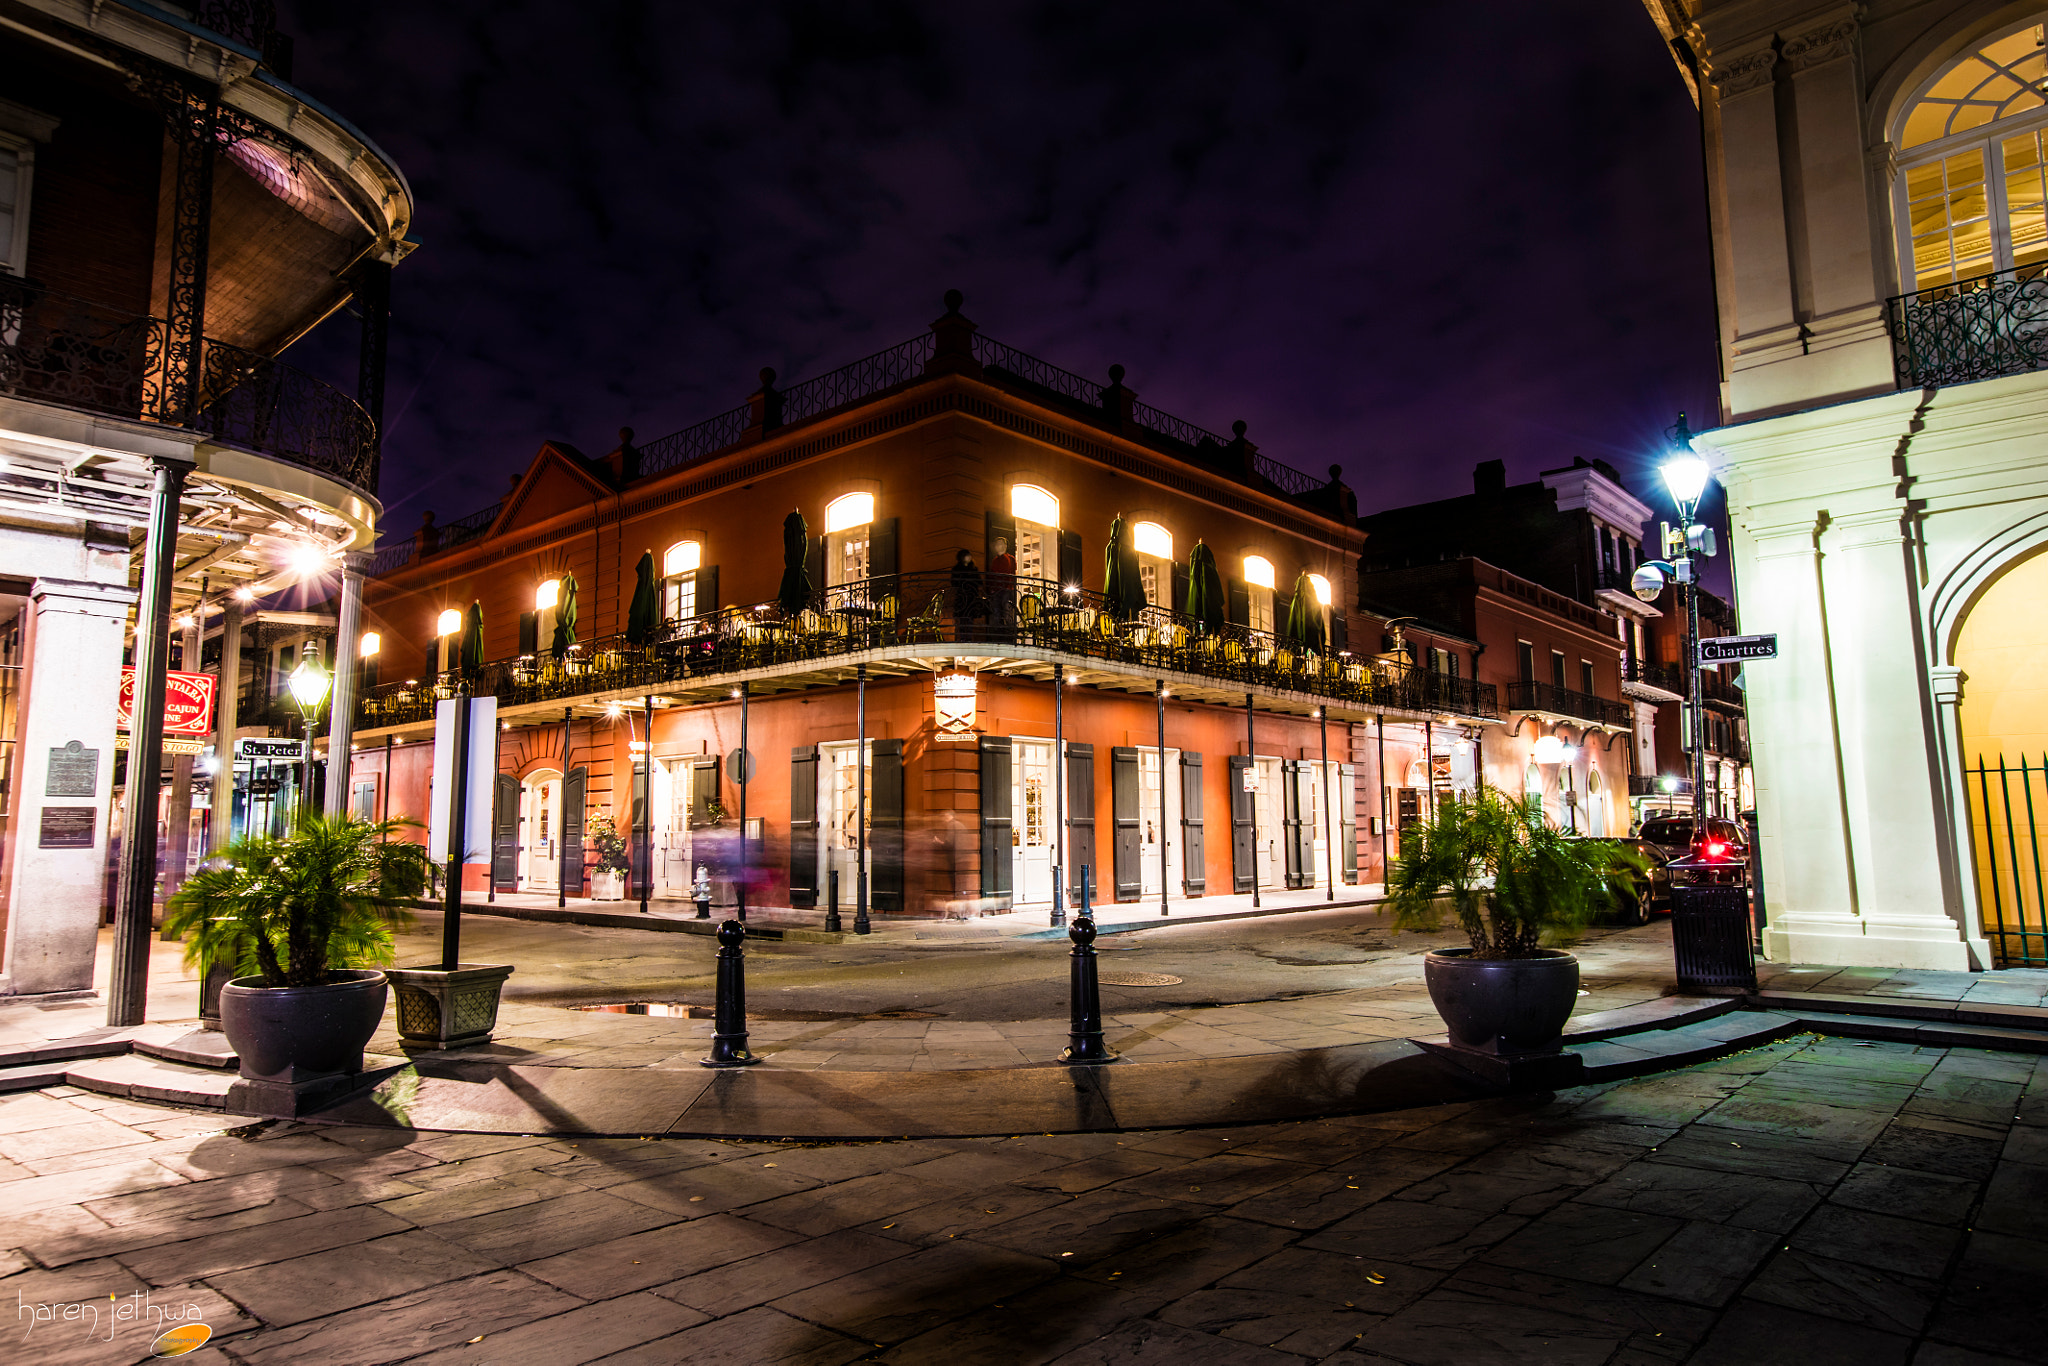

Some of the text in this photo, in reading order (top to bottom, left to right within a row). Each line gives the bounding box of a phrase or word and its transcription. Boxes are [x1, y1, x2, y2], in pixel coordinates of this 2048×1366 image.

[1704, 645, 1773, 658] Chartres
[166, 680, 203, 702] NTALBA
[167, 703, 200, 714] CAJUN
[243, 744, 301, 756] St. Peter
